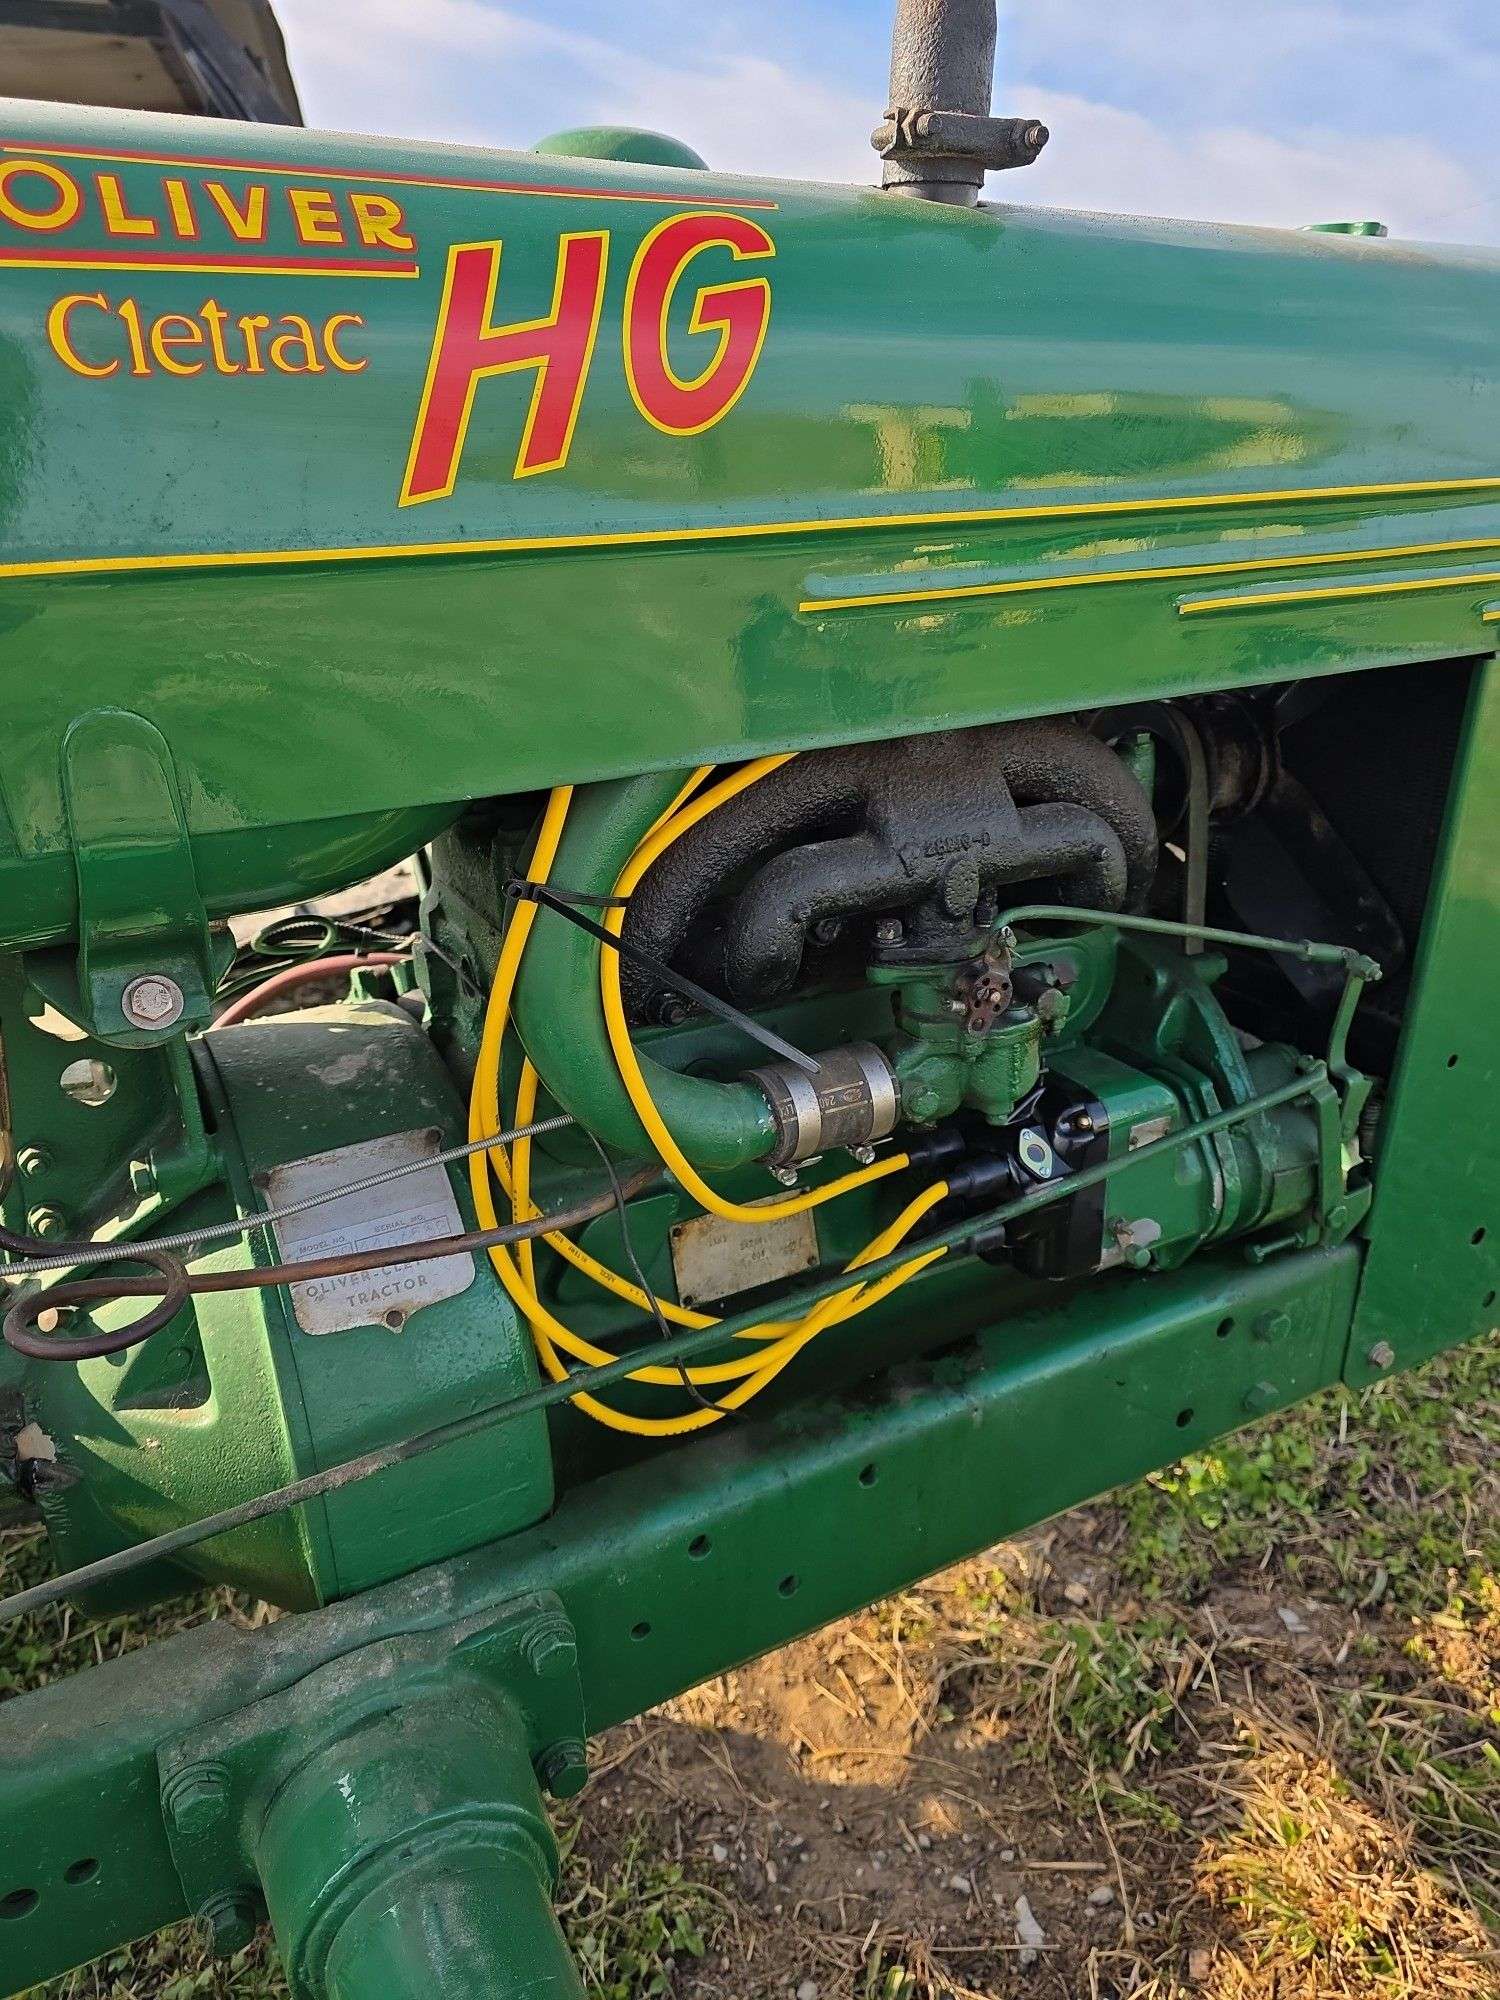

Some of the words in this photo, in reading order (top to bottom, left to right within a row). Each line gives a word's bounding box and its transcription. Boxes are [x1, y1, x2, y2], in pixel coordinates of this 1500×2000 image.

[0, 155, 416, 253] OLIVER
[47, 292, 369, 378] Cletrac
[398, 211, 776, 508] HG
[299, 1241, 328, 1253] MODEL
[346, 1274, 428, 1307] TRACTOR
